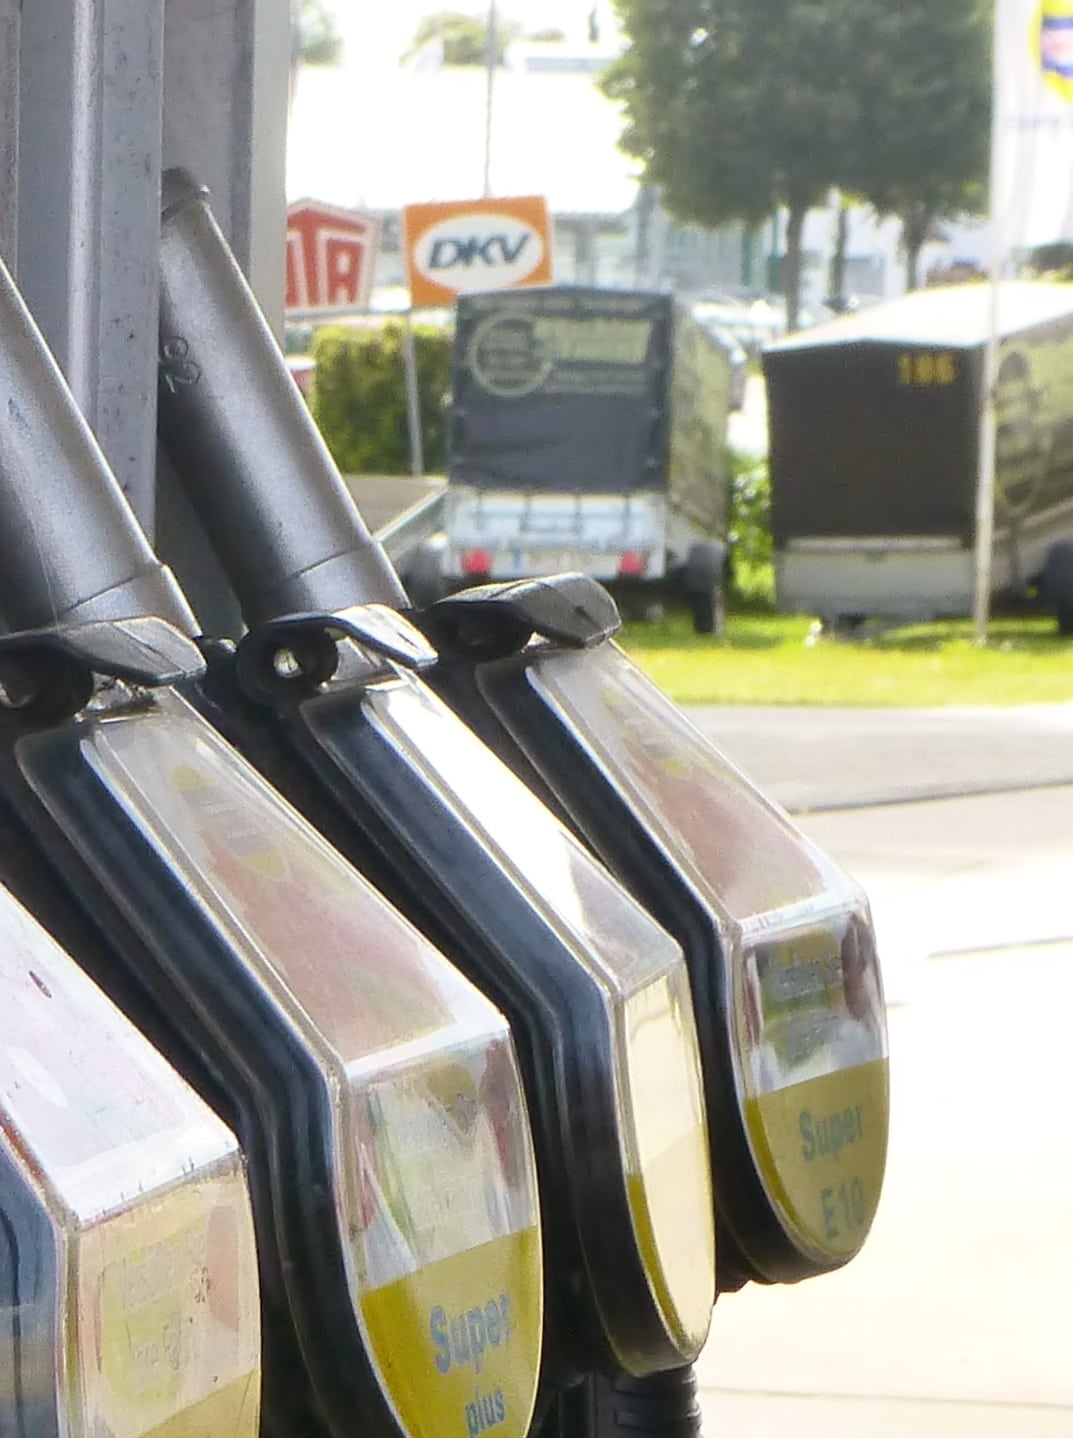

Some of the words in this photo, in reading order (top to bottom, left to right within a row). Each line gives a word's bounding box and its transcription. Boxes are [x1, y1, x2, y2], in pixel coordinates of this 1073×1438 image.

[285, 207, 367, 306] TA
[428, 232, 531, 269] DKV
[799, 1103, 864, 1163] Super
[821, 1177, 866, 1240] E10
[430, 1290, 511, 1374] Super
